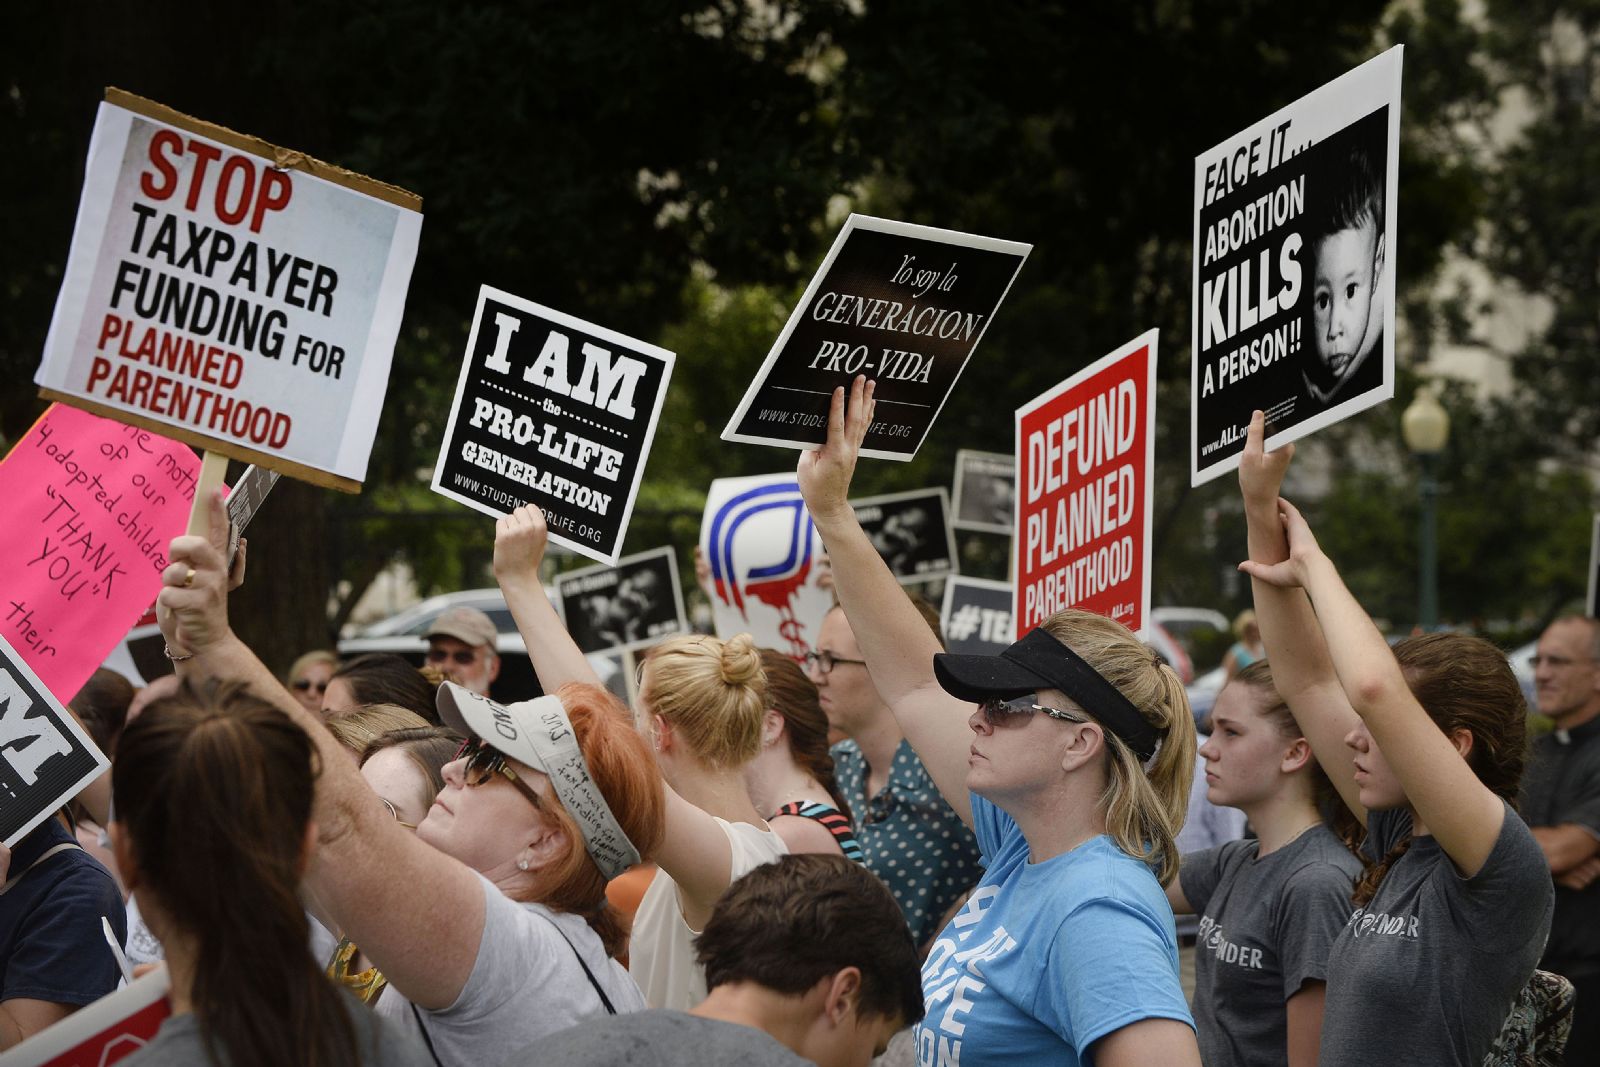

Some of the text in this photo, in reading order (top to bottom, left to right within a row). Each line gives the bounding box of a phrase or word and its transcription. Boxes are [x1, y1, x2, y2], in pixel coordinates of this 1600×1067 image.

[141, 129, 293, 234] STOP
[1200, 127, 1262, 209] FACE
[128, 203, 338, 317] TAXPAYER
[1203, 174, 1305, 266] ABORTION
[812, 291, 984, 342] GENERACION
[890, 254, 958, 299] Yo soy la
[1202, 232, 1303, 352] KILLS
[97, 314, 244, 390] PLANNED
[110, 260, 346, 380] FUNDING FOR
[1202, 317, 1302, 398] A PERSON!!
[484, 312, 648, 421] I AM
[808, 340, 936, 384] PRO-VIDA
[86, 357, 292, 450] PARENTHOOD
[469, 396, 625, 482] PRO-LIFE
[542, 397, 562, 416] the
[758, 408, 913, 438] WWW.STUDEIFE.ORG
[1027, 378, 1137, 504] DEFUND
[1202, 424, 1249, 457] www.ALL.or
[46, 444, 123, 513] adopted
[100, 443, 166, 506] of our
[123, 423, 196, 502] he moth
[461, 440, 612, 516] GENERATION
[454, 472, 602, 543] WWW.STUDENTORLIFE.ORG
[1026, 463, 1135, 574] PLANNED
[1025, 535, 1133, 628] PARENTHOOD
[6, 600, 57, 658] their
